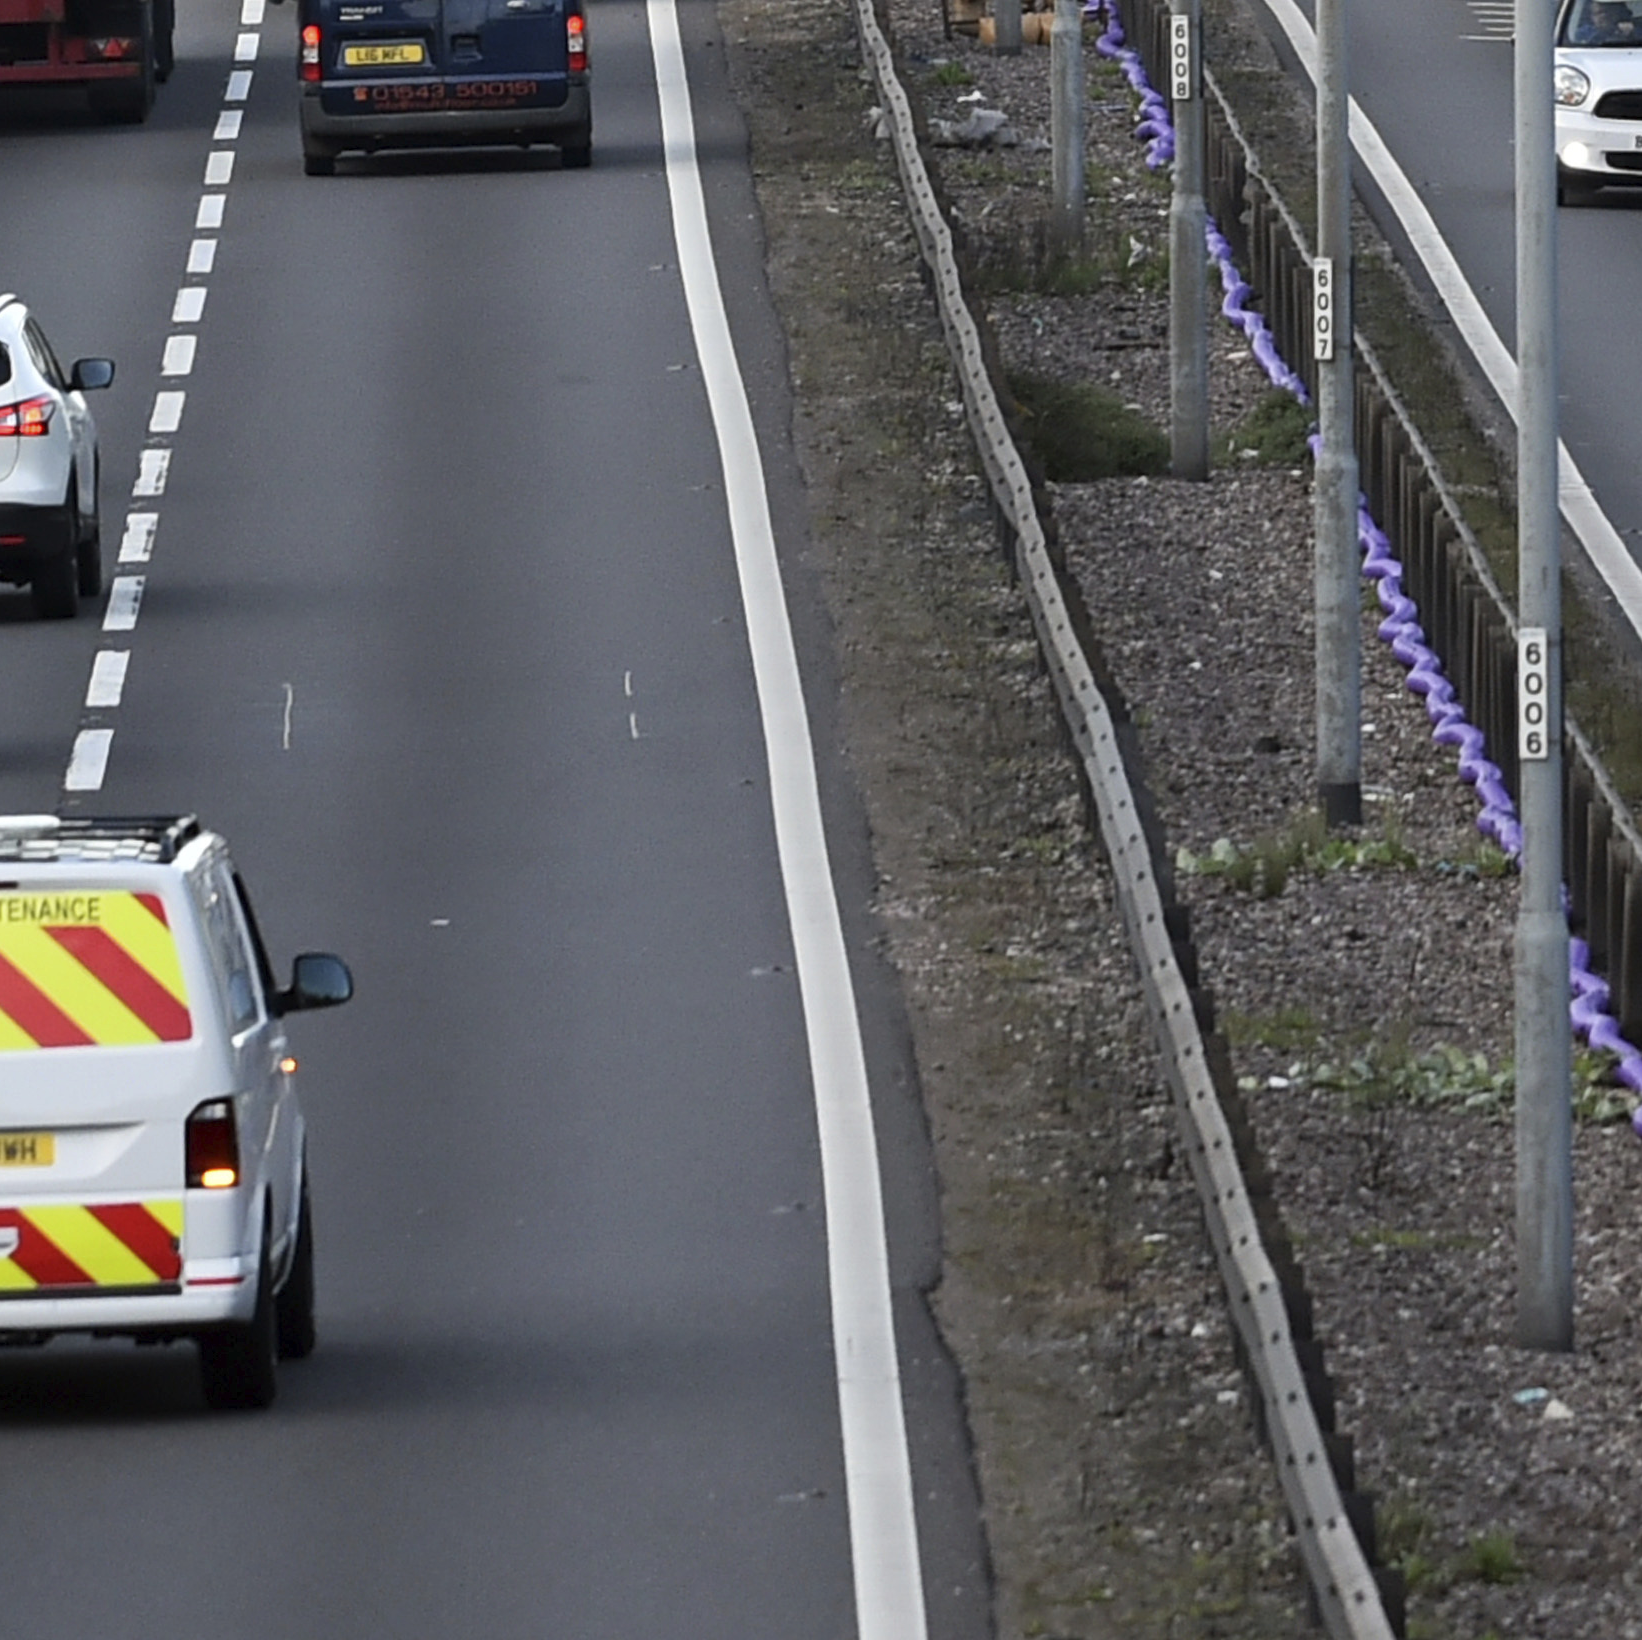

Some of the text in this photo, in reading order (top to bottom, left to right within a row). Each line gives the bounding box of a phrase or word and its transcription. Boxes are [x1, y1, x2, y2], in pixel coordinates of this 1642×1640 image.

[1175, 24, 1187, 97] 6008
[1317, 269, 1329, 357] 6007
[1524, 641, 1543, 755] 6006
